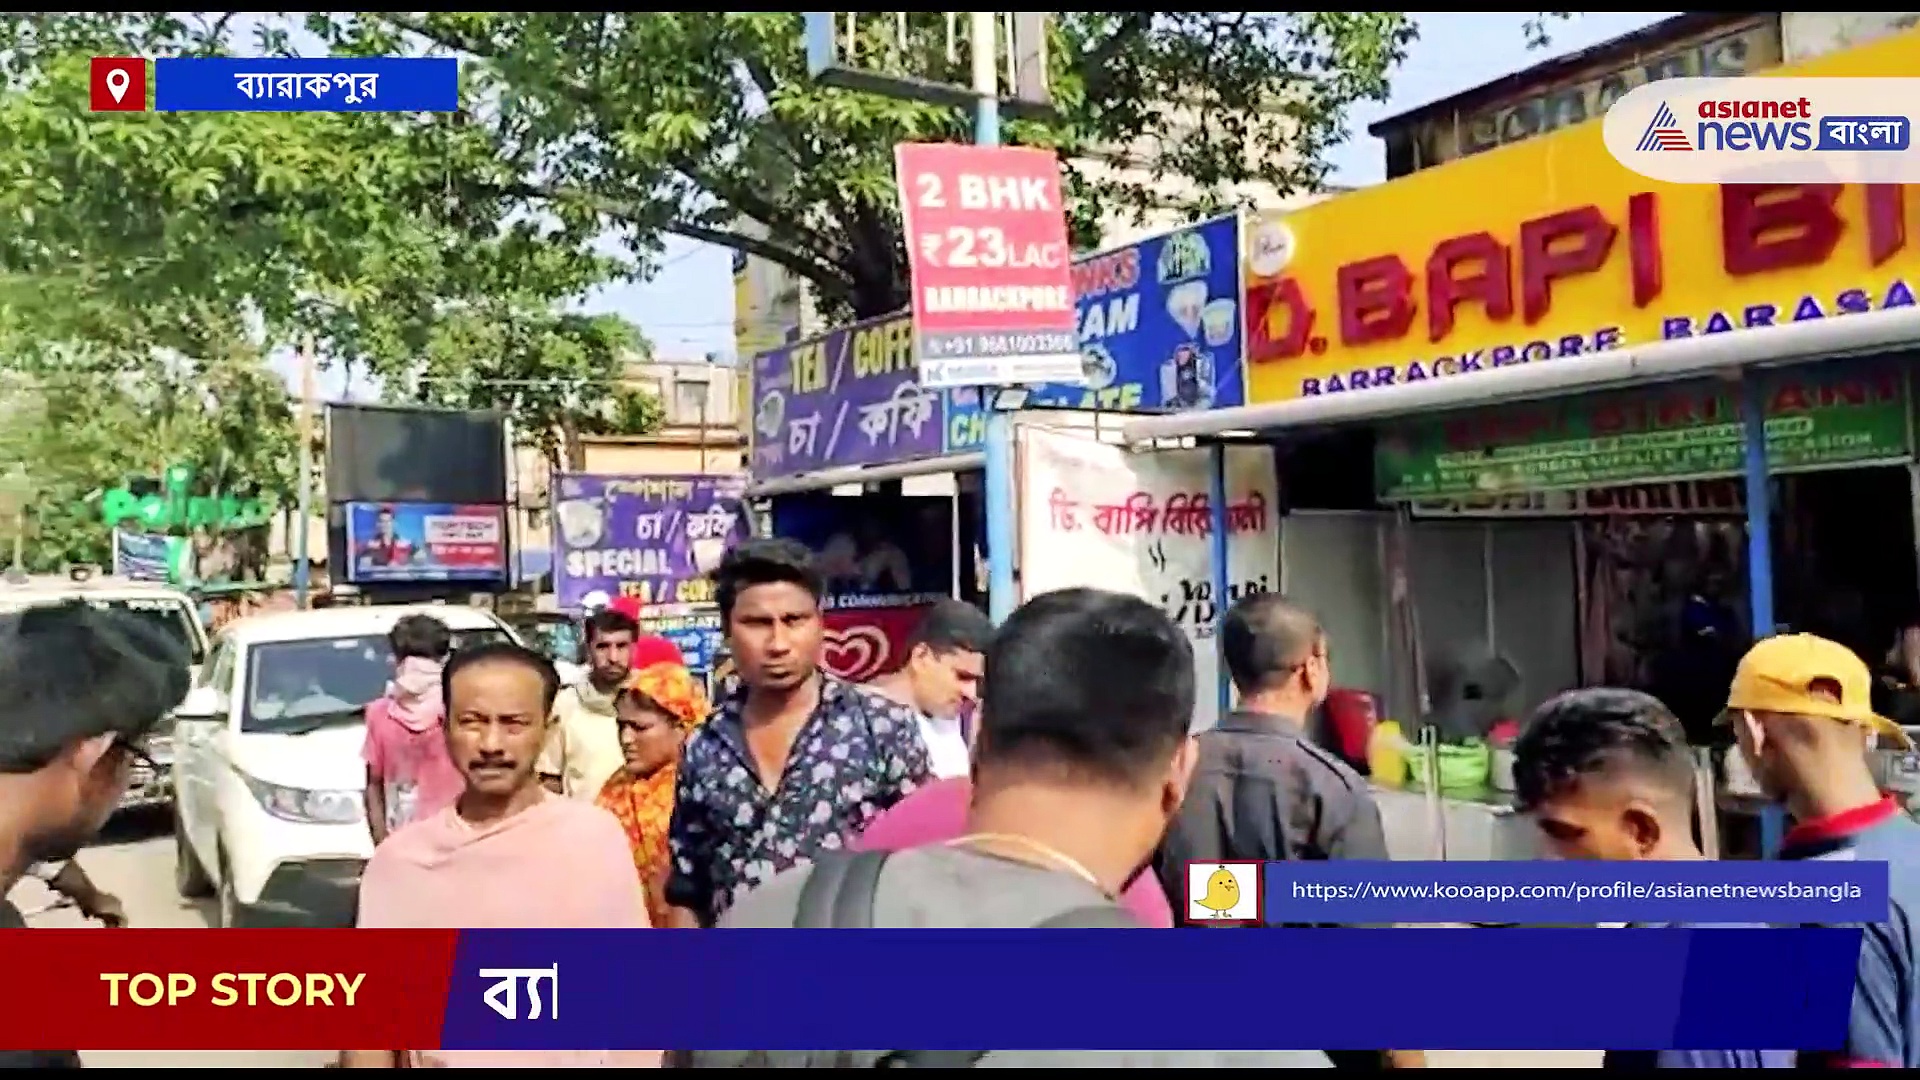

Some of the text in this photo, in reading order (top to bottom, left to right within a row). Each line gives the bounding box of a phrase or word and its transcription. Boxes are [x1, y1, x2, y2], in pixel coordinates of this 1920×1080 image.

[916, 173, 1052, 211] 2 BHK
[790, 343, 828, 395] TEA
[1301, 325, 1626, 397] BARRACKPORE
[788, 410, 823, 458] চা
[857, 379, 940, 449] কফি
[636, 510, 666, 541] চা
[1092, 490, 1159, 536] বাপি
[567, 547, 674, 579] SPECIAL
